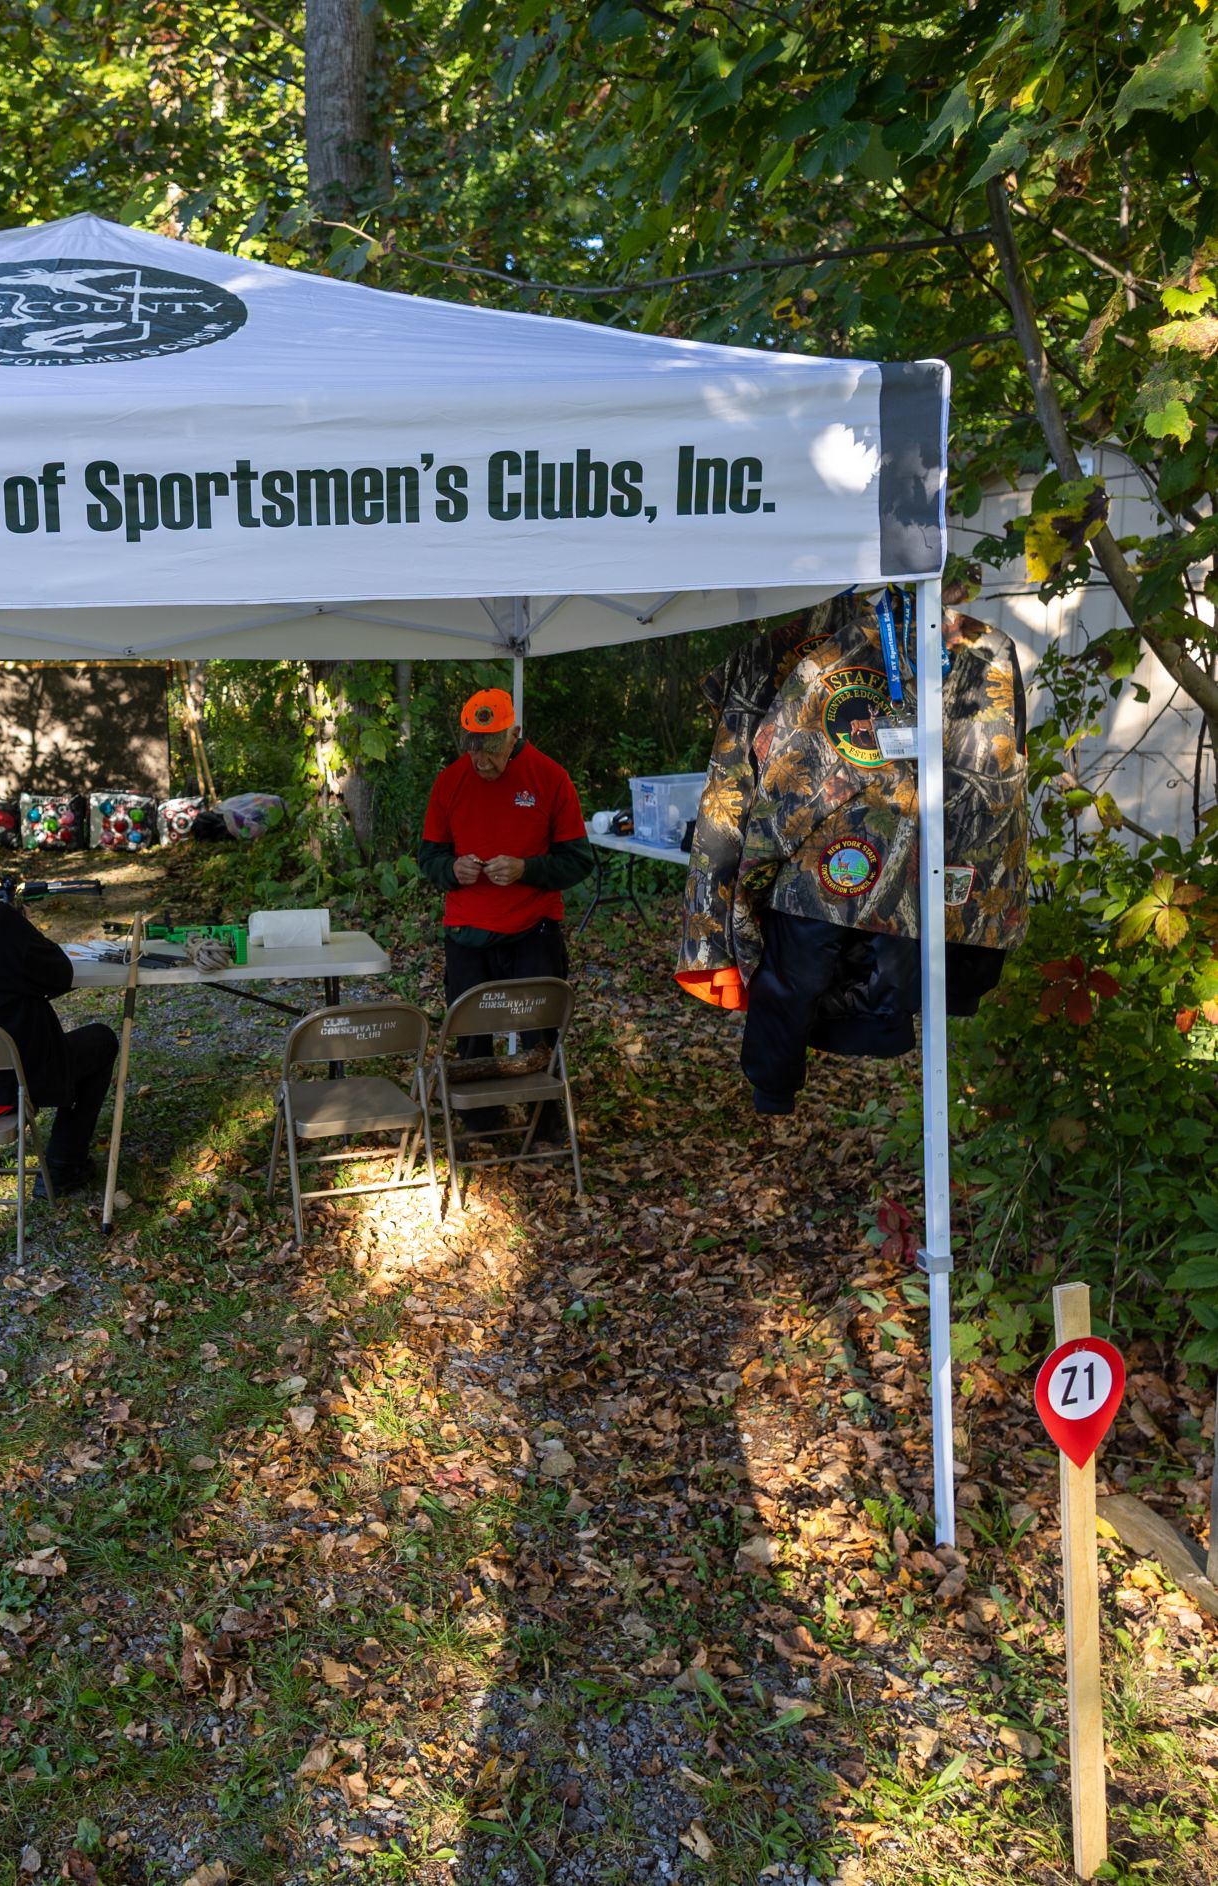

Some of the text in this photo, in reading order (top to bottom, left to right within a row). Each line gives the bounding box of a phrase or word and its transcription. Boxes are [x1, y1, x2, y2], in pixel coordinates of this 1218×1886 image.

[19, 301, 223, 314] COUNTY
[3, 461, 66, 534] of
[84, 453, 469, 543] Sportsmen’s
[487, 448, 658, 524] Clubs,
[676, 445, 776, 518] Inc.
[827, 691, 852, 722] HUNTER
[849, 747, 867, 760] EST.
[827, 840, 877, 863] NEW YORK STATE
[479, 996, 547, 1009] CONSERVATION
[320, 1020, 397, 1036] CONSERVATION
[323, 1017, 350, 1028] ELMA
[356, 1030, 381, 1041] CLUB
[1061, 1361, 1094, 1407] Z1
